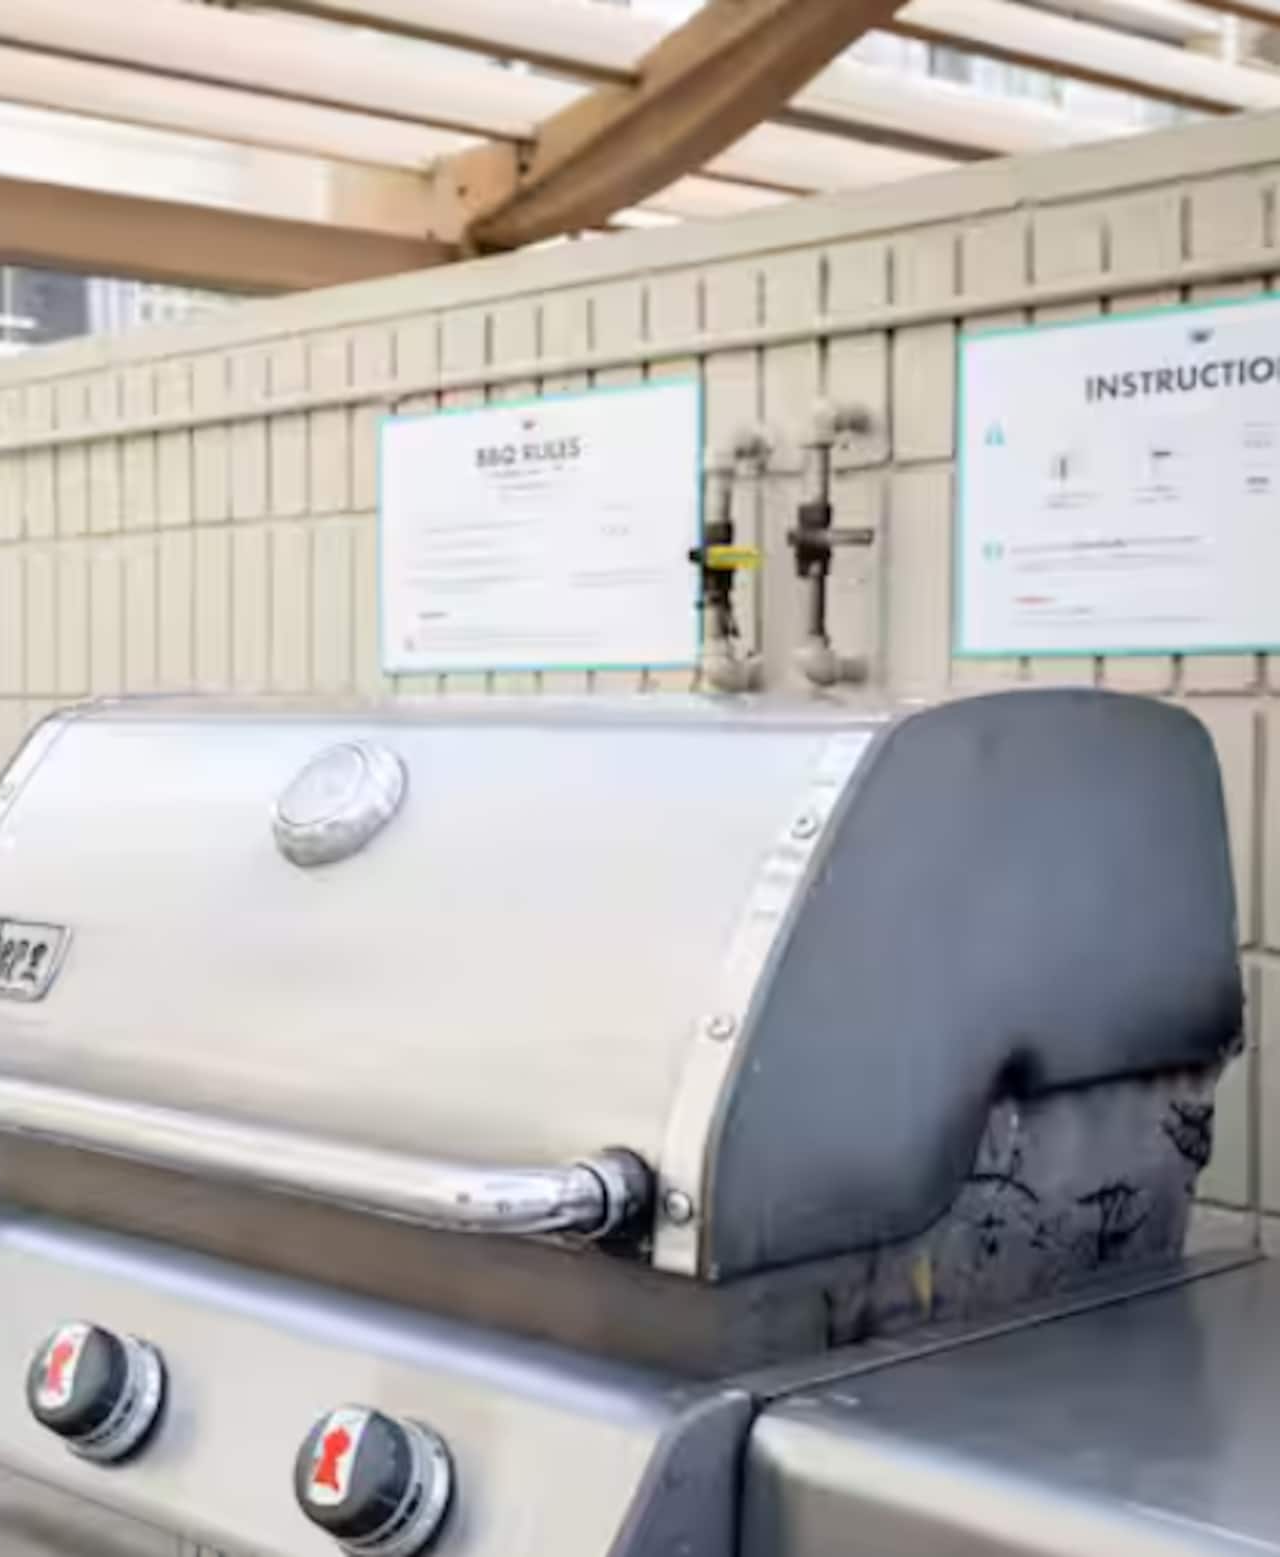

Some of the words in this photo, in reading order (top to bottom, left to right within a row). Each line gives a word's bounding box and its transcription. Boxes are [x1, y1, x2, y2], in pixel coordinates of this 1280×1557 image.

[1086, 355, 1280, 403] INSTRUCTIO
[476, 444, 517, 468] BBQ
[522, 436, 582, 461] RULES
